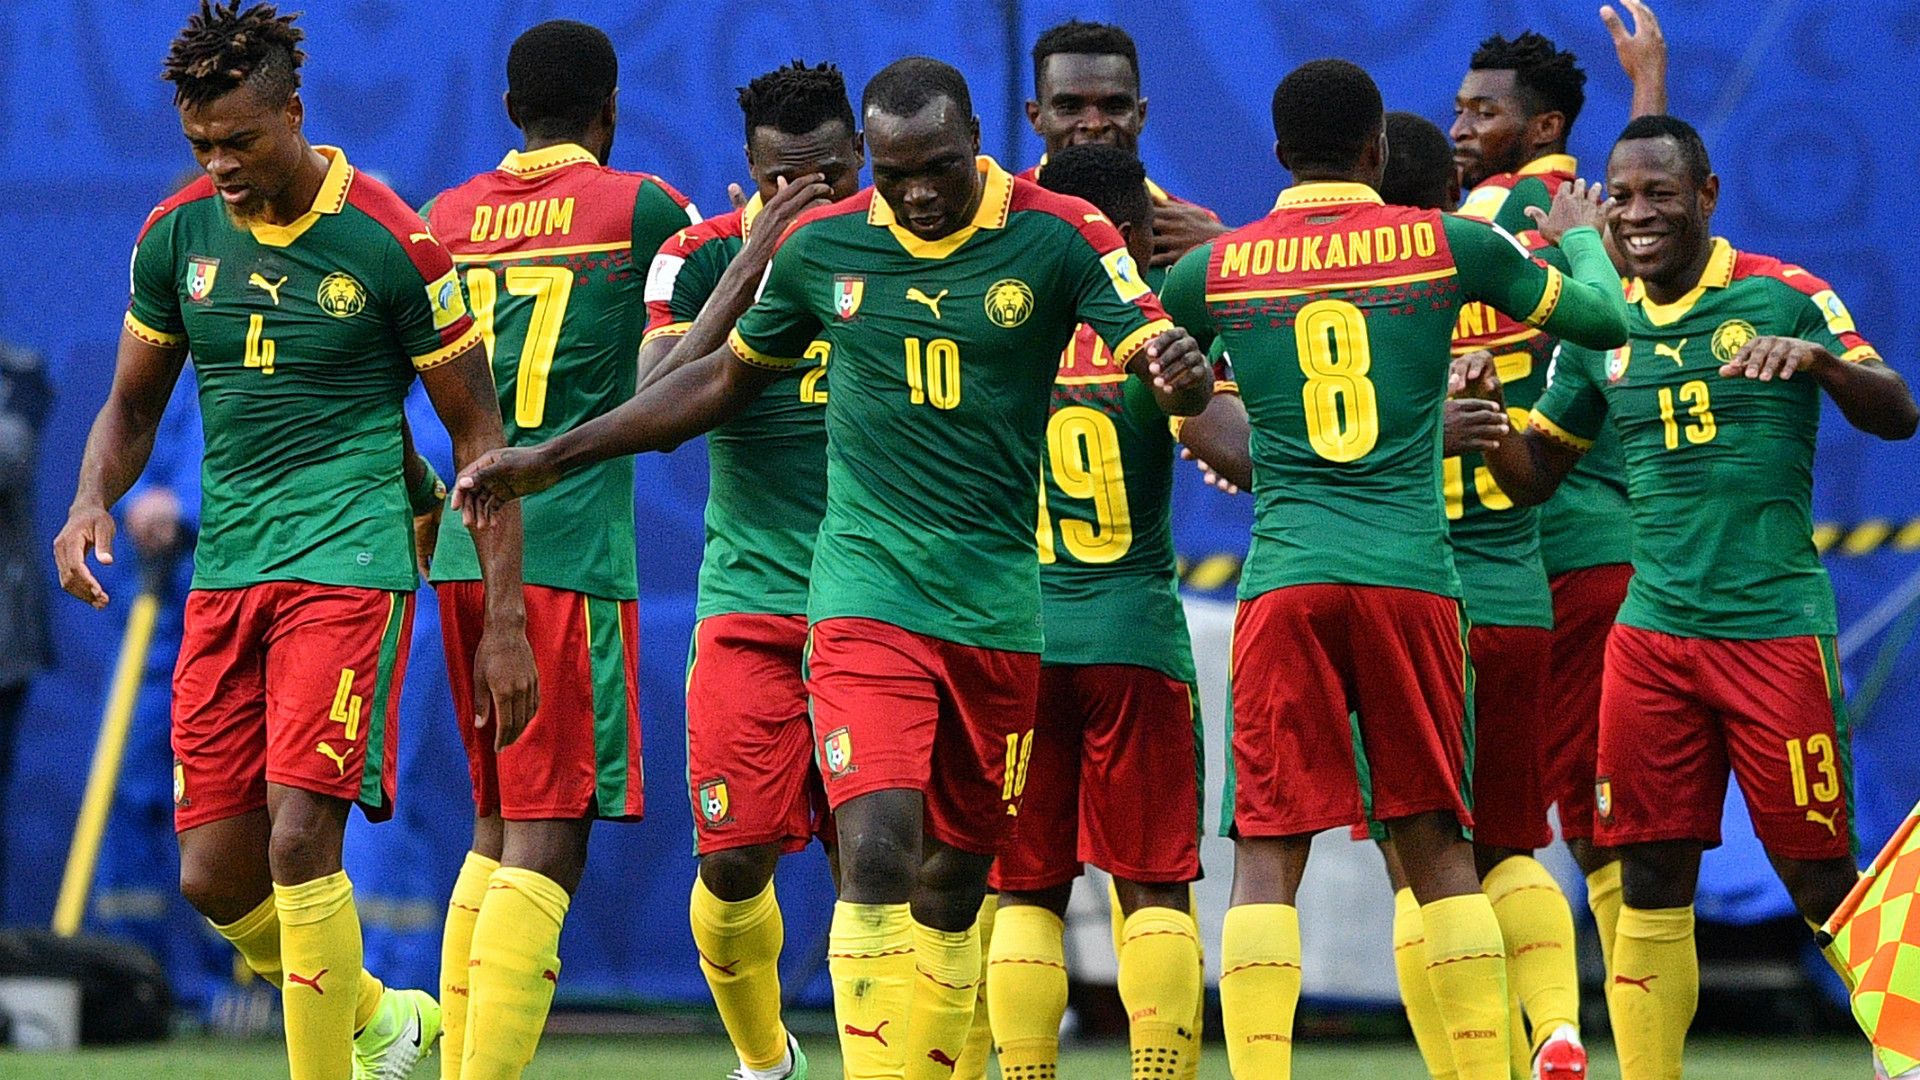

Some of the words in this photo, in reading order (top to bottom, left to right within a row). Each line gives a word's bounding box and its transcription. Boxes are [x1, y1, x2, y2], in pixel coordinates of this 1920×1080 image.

[470, 197, 574, 241] DJOUM
[1220, 222, 1436, 278] MOUKANDJO
[243, 313, 276, 375] 4
[904, 337, 961, 410] 10
[1293, 298, 1379, 463] 8
[1658, 380, 1717, 450] 13
[329, 668, 363, 741] 4
[1001, 728, 1035, 801] 10
[1787, 733, 1840, 807] 13
